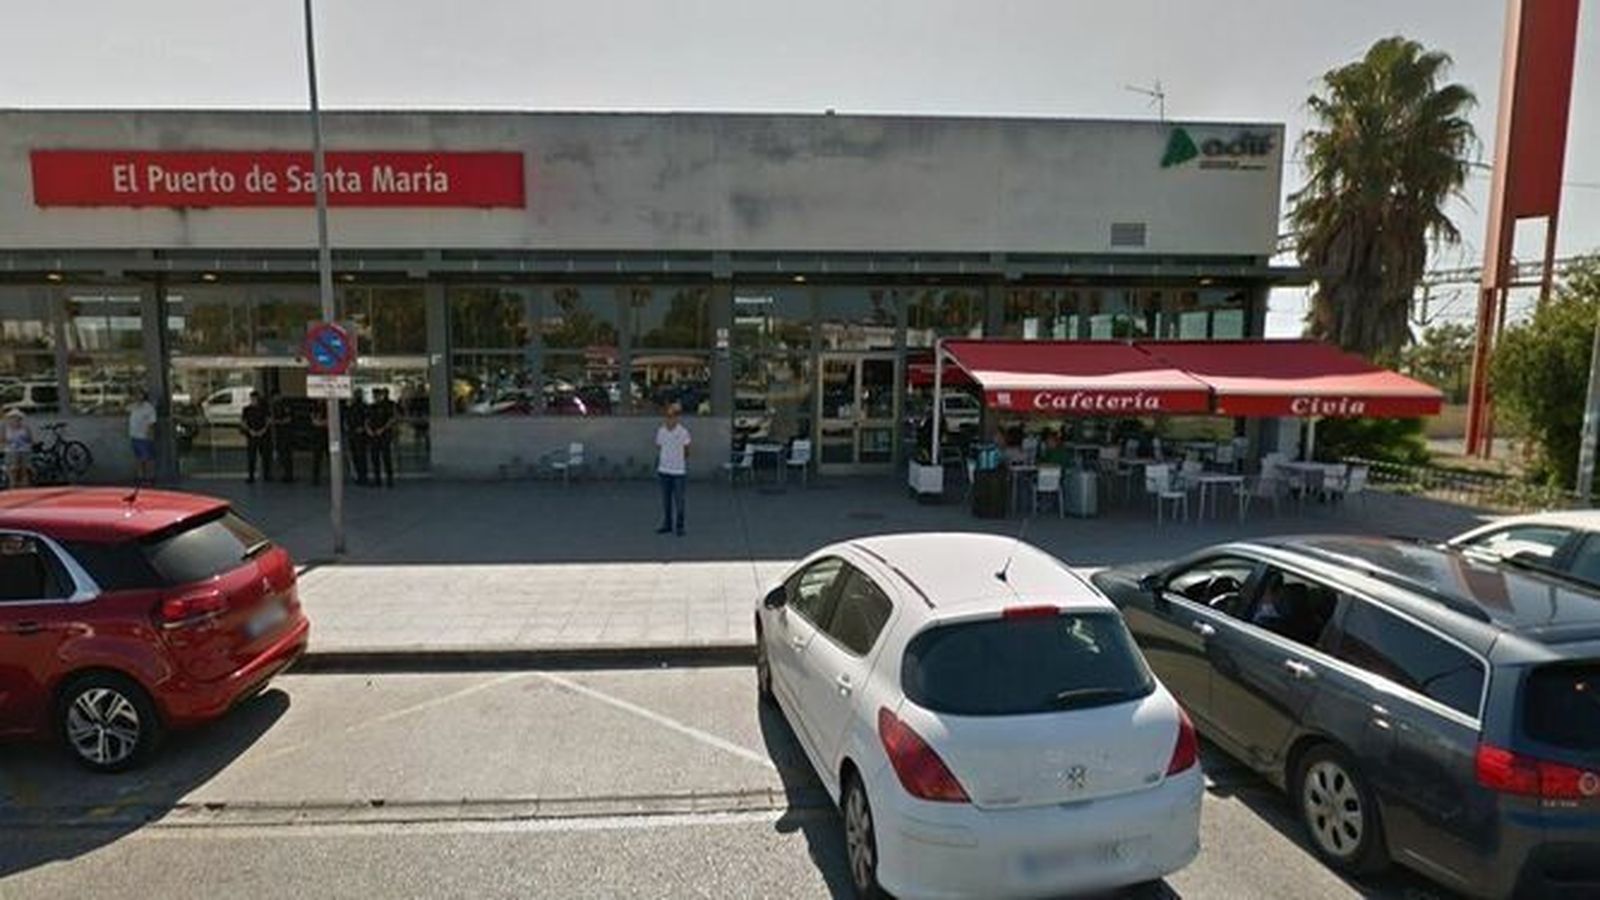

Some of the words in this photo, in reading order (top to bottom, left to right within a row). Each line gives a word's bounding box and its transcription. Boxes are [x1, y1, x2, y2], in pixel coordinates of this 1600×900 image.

[113, 164, 139, 193] El
[148, 165, 236, 193] Puerto
[245, 164, 278, 193] de
[287, 165, 362, 193] Santa
[372, 163, 449, 193] María
[1290, 397, 1366, 415] Civia
